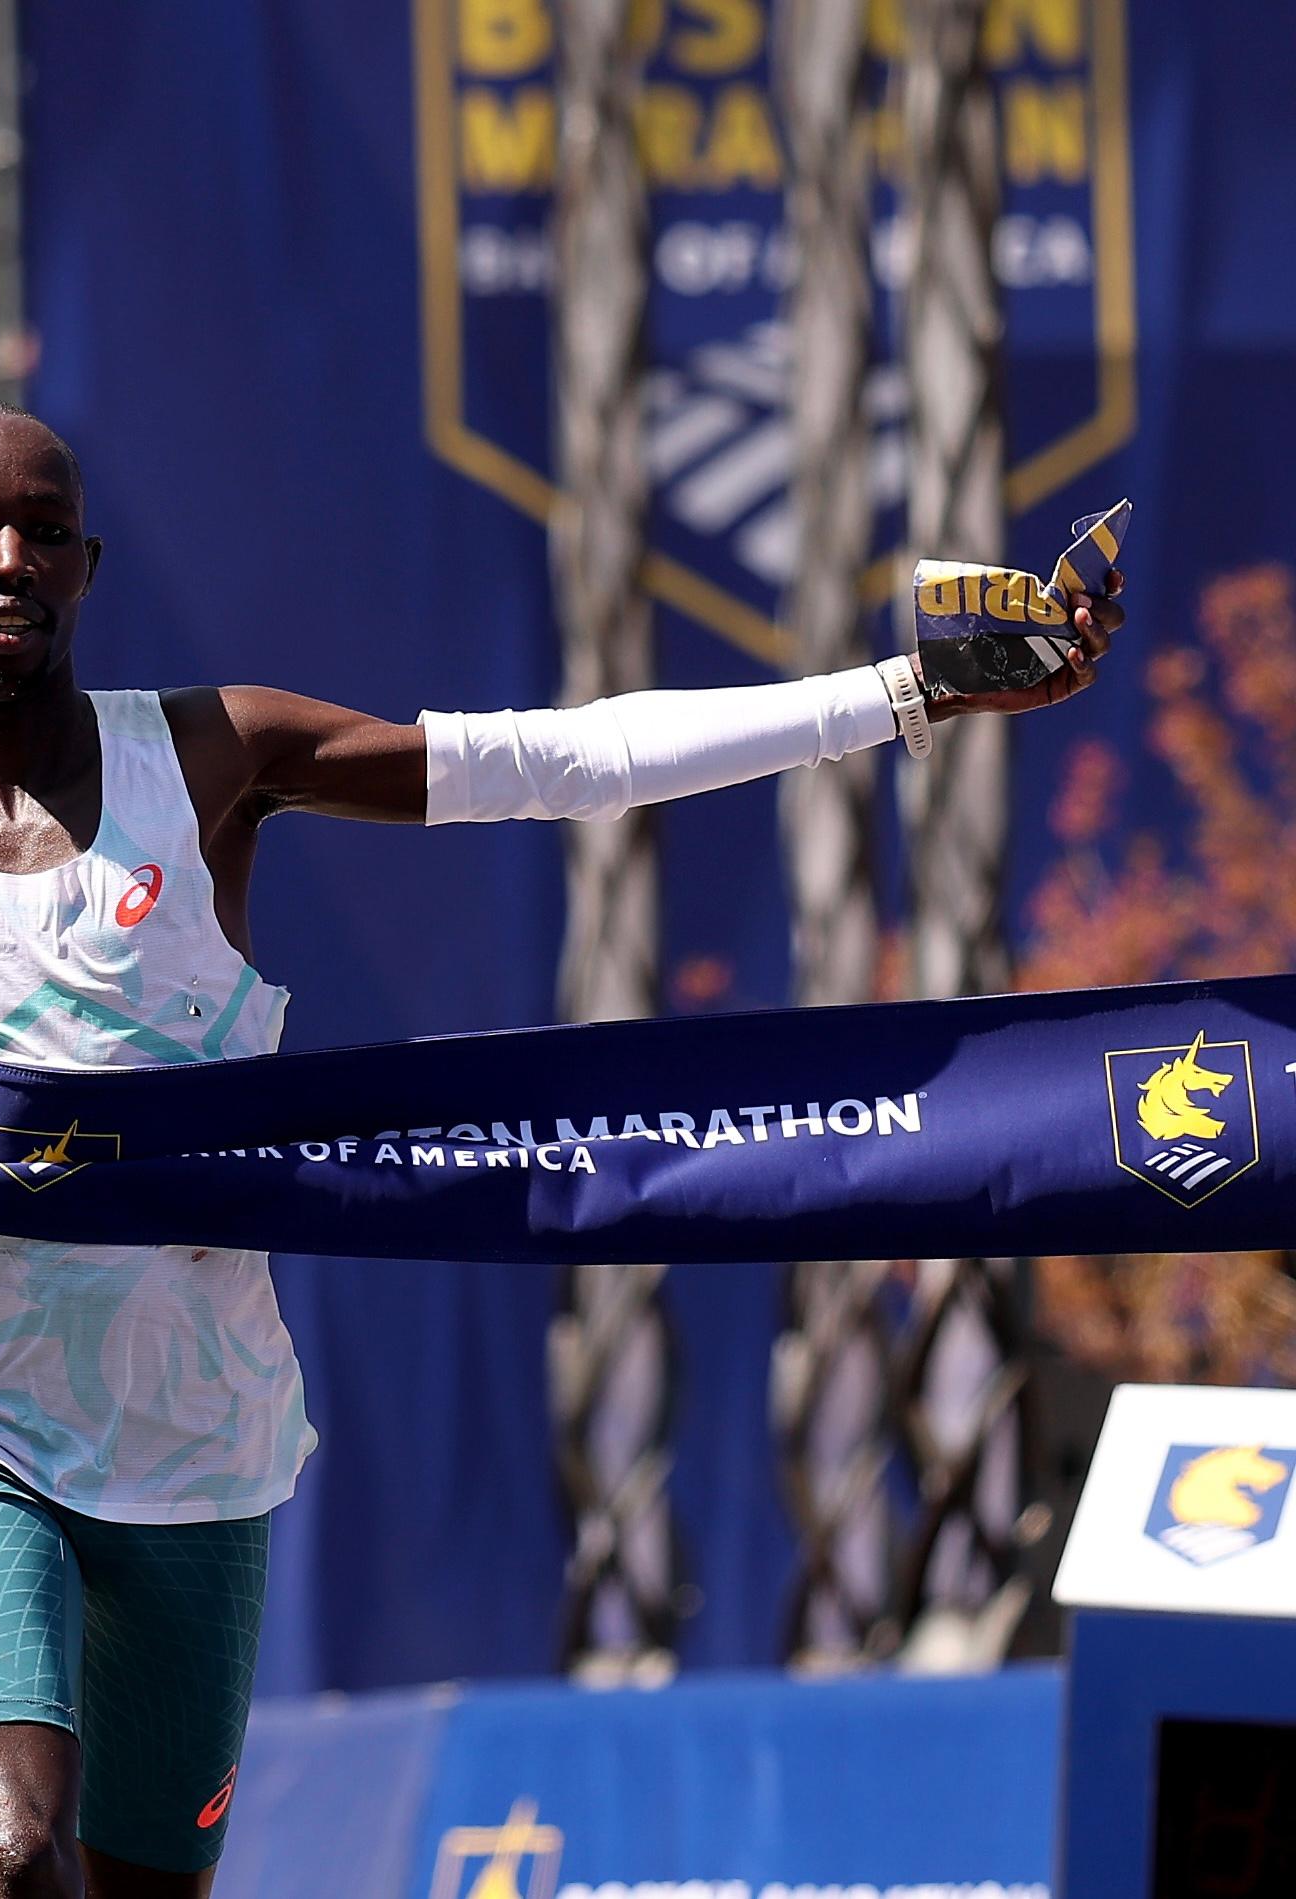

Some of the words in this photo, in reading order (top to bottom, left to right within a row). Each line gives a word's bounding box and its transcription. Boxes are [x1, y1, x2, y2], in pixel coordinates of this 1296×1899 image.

[556, 1093, 920, 1149] MARATHON
[299, 1142, 358, 1163] OF
[374, 1145, 597, 1174] AMERICA
